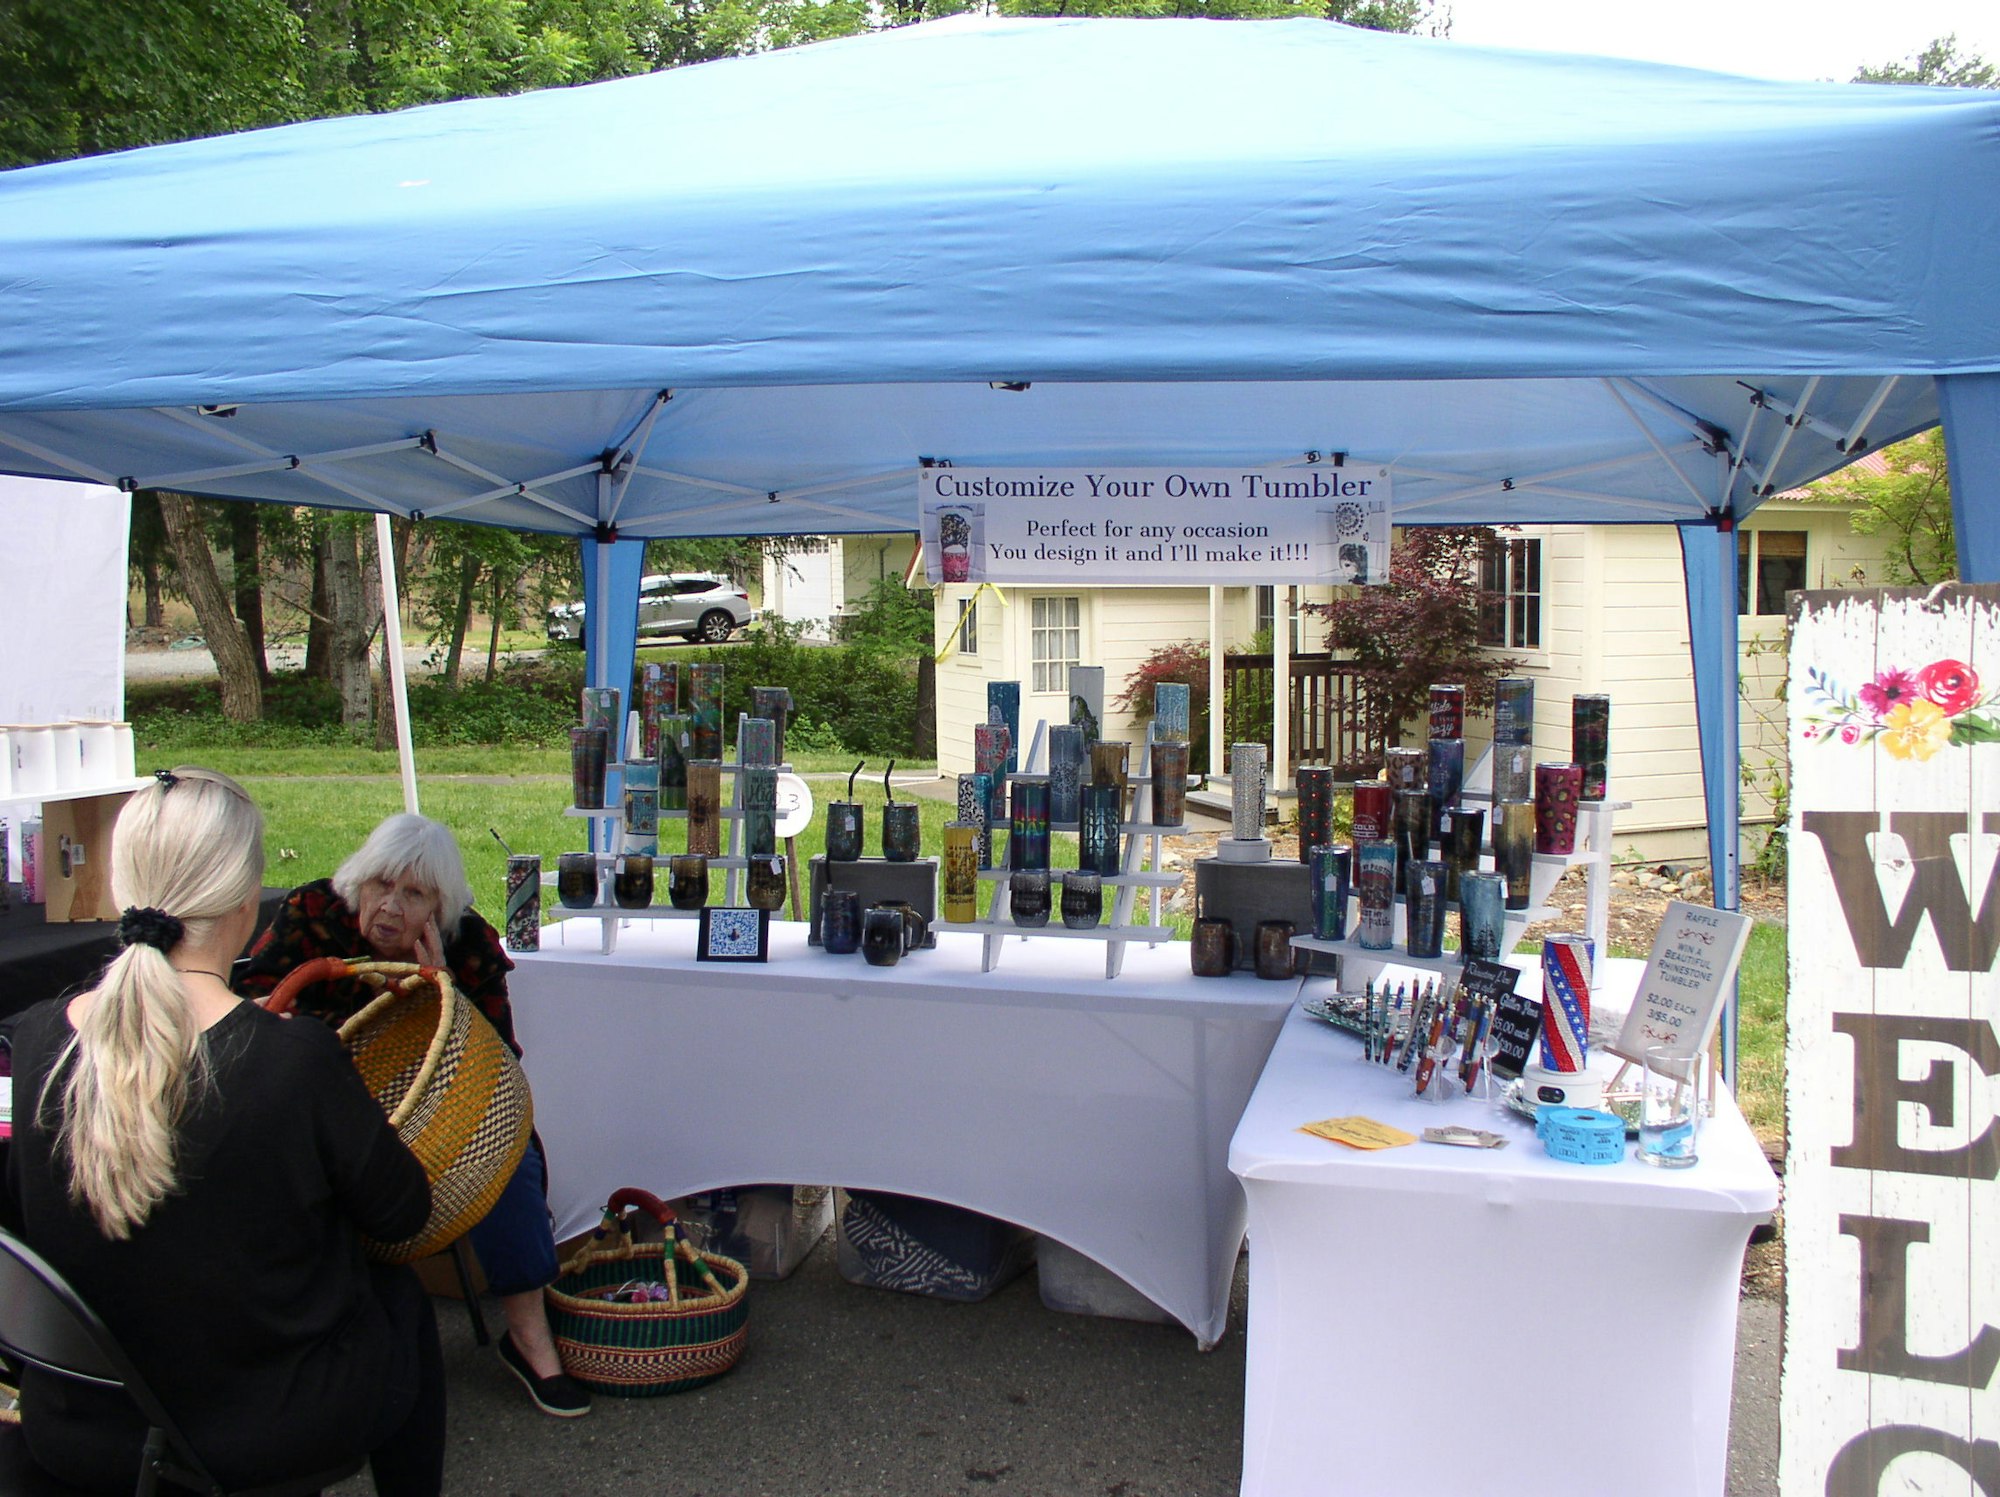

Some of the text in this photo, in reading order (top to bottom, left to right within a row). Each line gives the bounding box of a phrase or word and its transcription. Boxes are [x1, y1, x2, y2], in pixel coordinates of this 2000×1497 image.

[936, 472, 1372, 498] Customize Your Own Tumbler
[1026, 519, 1269, 543] Perfect for any occasion
[989, 543, 1309, 566] You design it and I'll make it!!!
[1685, 911, 1719, 928] RAFFLE
[1664, 949, 1713, 970] BEAUTIFUL
[1677, 942, 1702, 955] WIN A
[1657, 959, 1713, 982] RHINESTONE
[1659, 970, 1700, 990] TUMBLER
[1647, 992, 1697, 1017] $2.00 EACH
[1647, 1009, 1683, 1028] 3/$5.00
